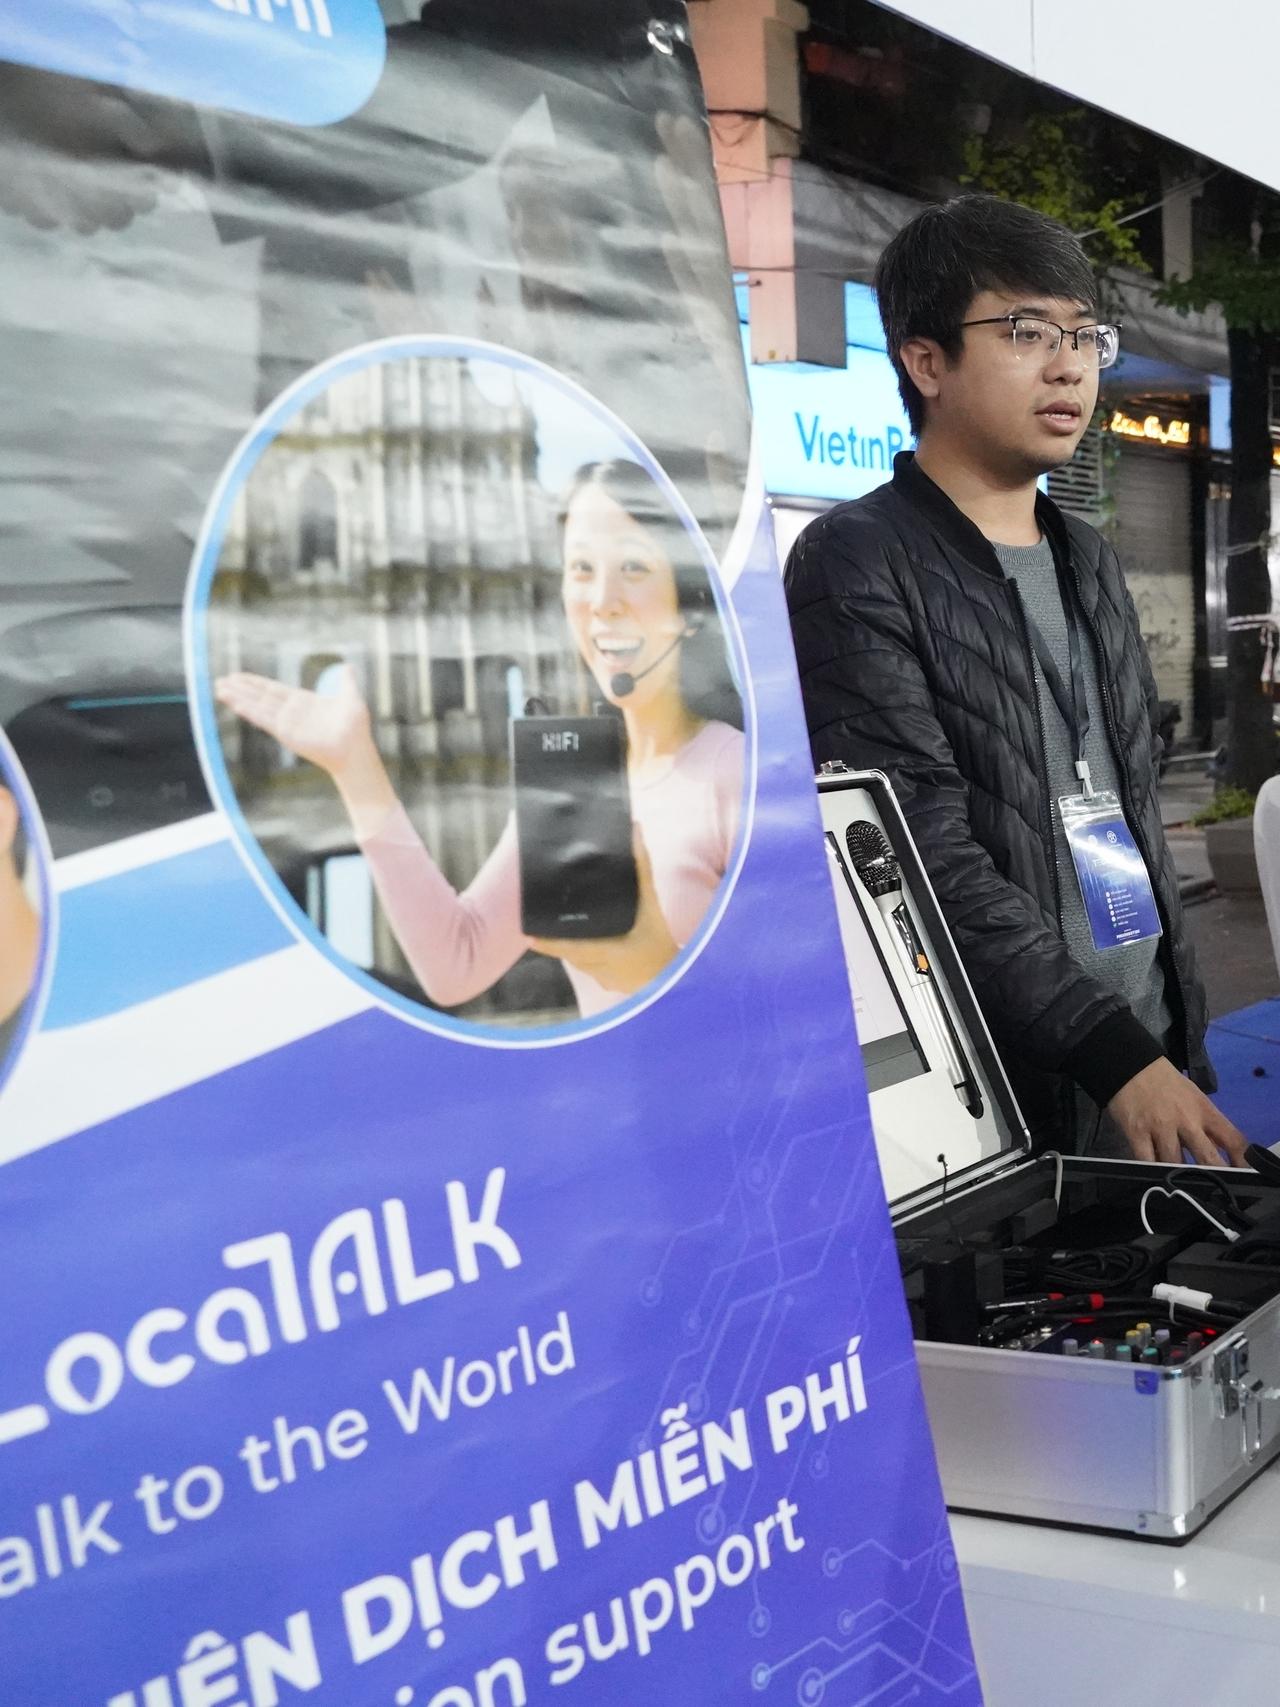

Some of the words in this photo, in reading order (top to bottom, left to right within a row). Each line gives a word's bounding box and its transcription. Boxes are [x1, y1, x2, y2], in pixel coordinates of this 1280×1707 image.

[794, 411, 914, 472] VietinB
[0, 1495, 122, 1598] alk
[135, 1465, 224, 1535] to
[238, 1409, 369, 1493] the
[382, 1311, 576, 1434] World
[342, 1499, 559, 1664] DỊCH
[573, 1402, 753, 1550] MIỄN
[765, 1335, 869, 1454] PHÍ
[544, 1497, 806, 1686] support
